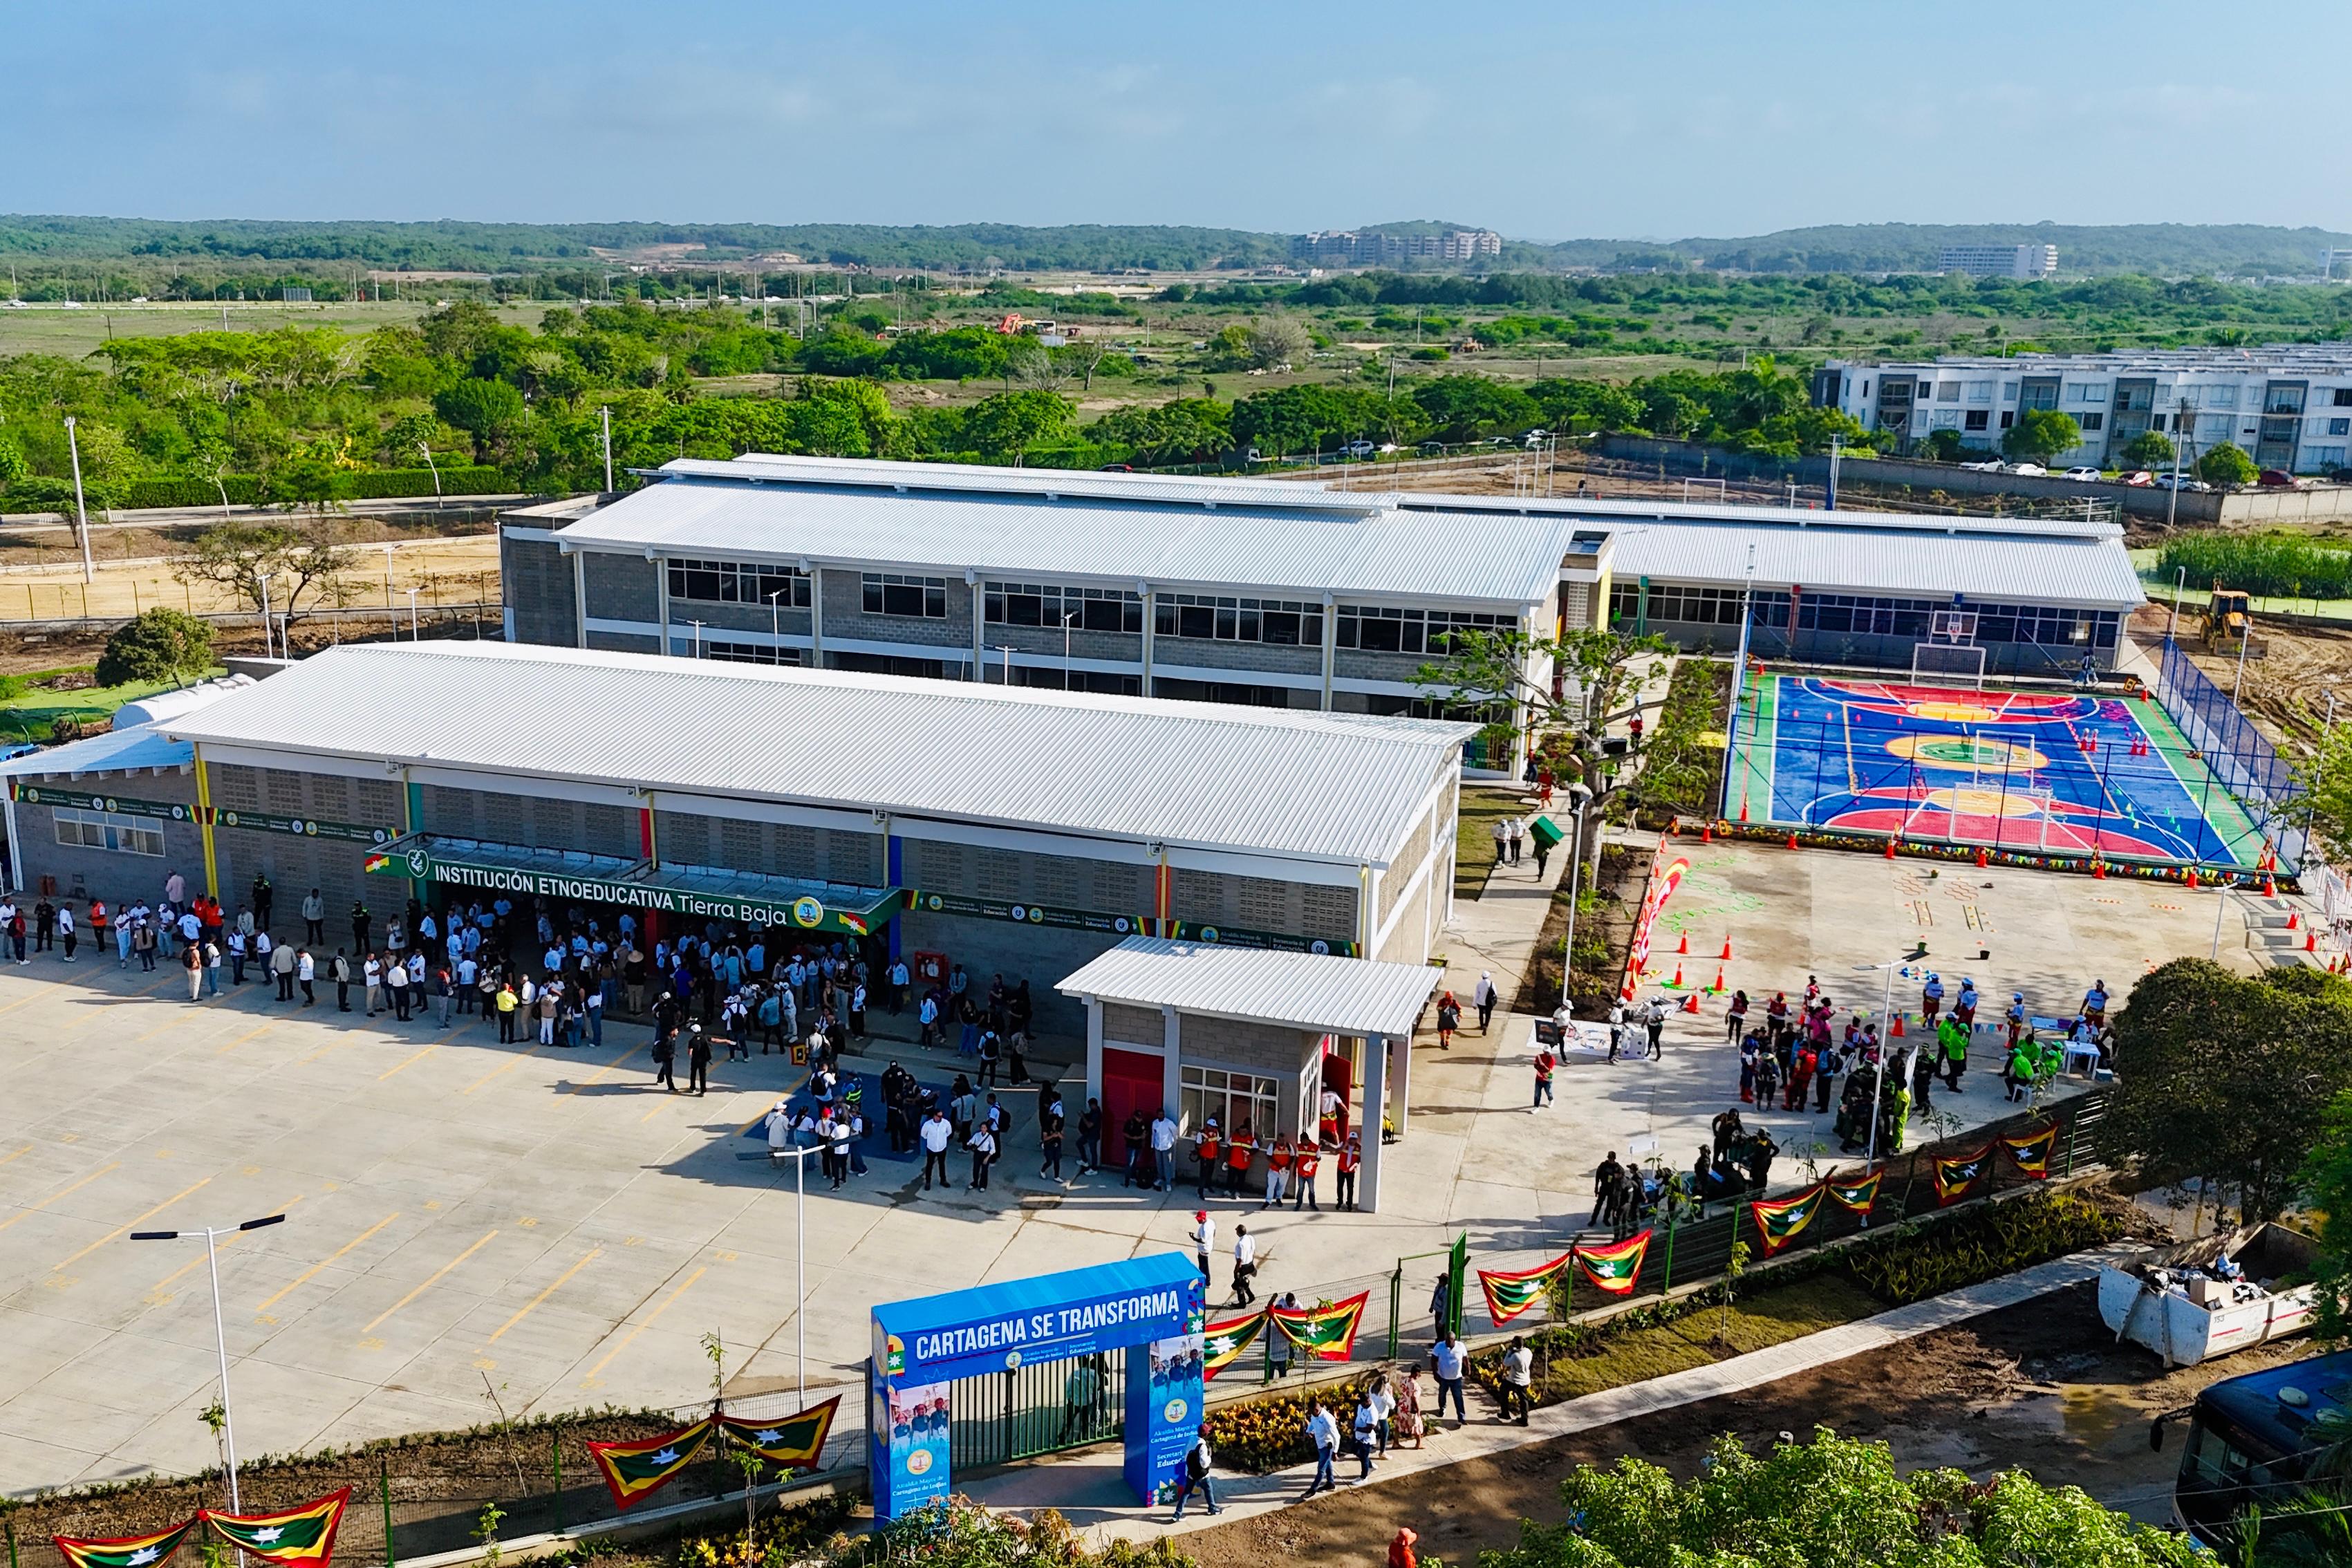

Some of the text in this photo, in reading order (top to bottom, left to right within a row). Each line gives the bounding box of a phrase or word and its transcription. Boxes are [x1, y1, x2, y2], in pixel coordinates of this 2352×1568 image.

[435, 865, 787, 927] INSTITUCIÓN ETNOEDUCATIVA Tierra Baja
[916, 1290, 1179, 1360] CARTAGENA SE TRANSFORMA
[1150, 1435, 1177, 1444] Cartagena
[893, 1487, 921, 1496] Cartagena
